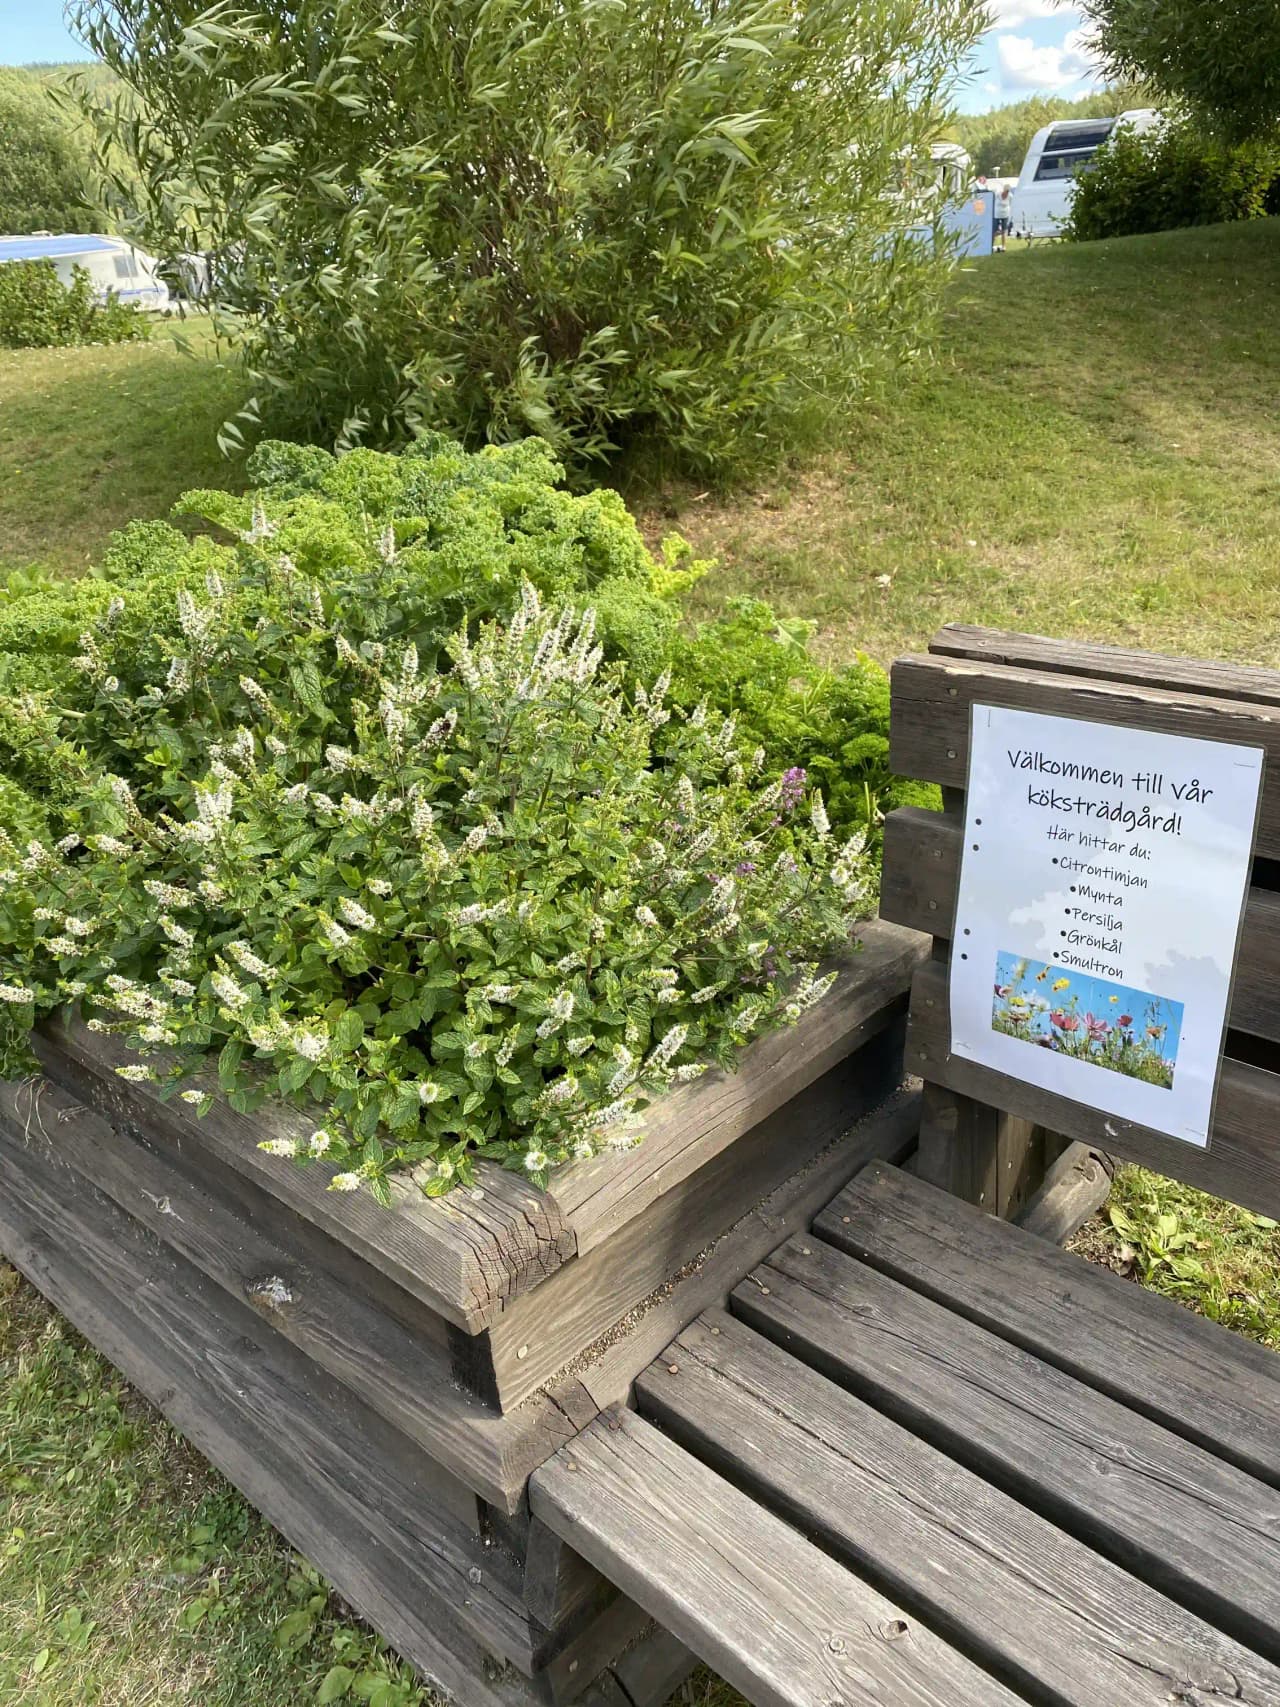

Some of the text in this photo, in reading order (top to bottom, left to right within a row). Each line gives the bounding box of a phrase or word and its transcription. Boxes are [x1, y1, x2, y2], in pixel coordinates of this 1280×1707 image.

[1007, 749, 1214, 804] Välkommen till vår
[1027, 784, 1182, 836] köksträdgård!
[1046, 824, 1151, 860] Här hittar du:
[1060, 857, 1148, 889] Citrontimjan
[1078, 884, 1123, 906] Mynta
[1072, 907, 1123, 931] Persilja
[1067, 929, 1122, 954] Grönkål
[1061, 950, 1124, 980] Smultron
